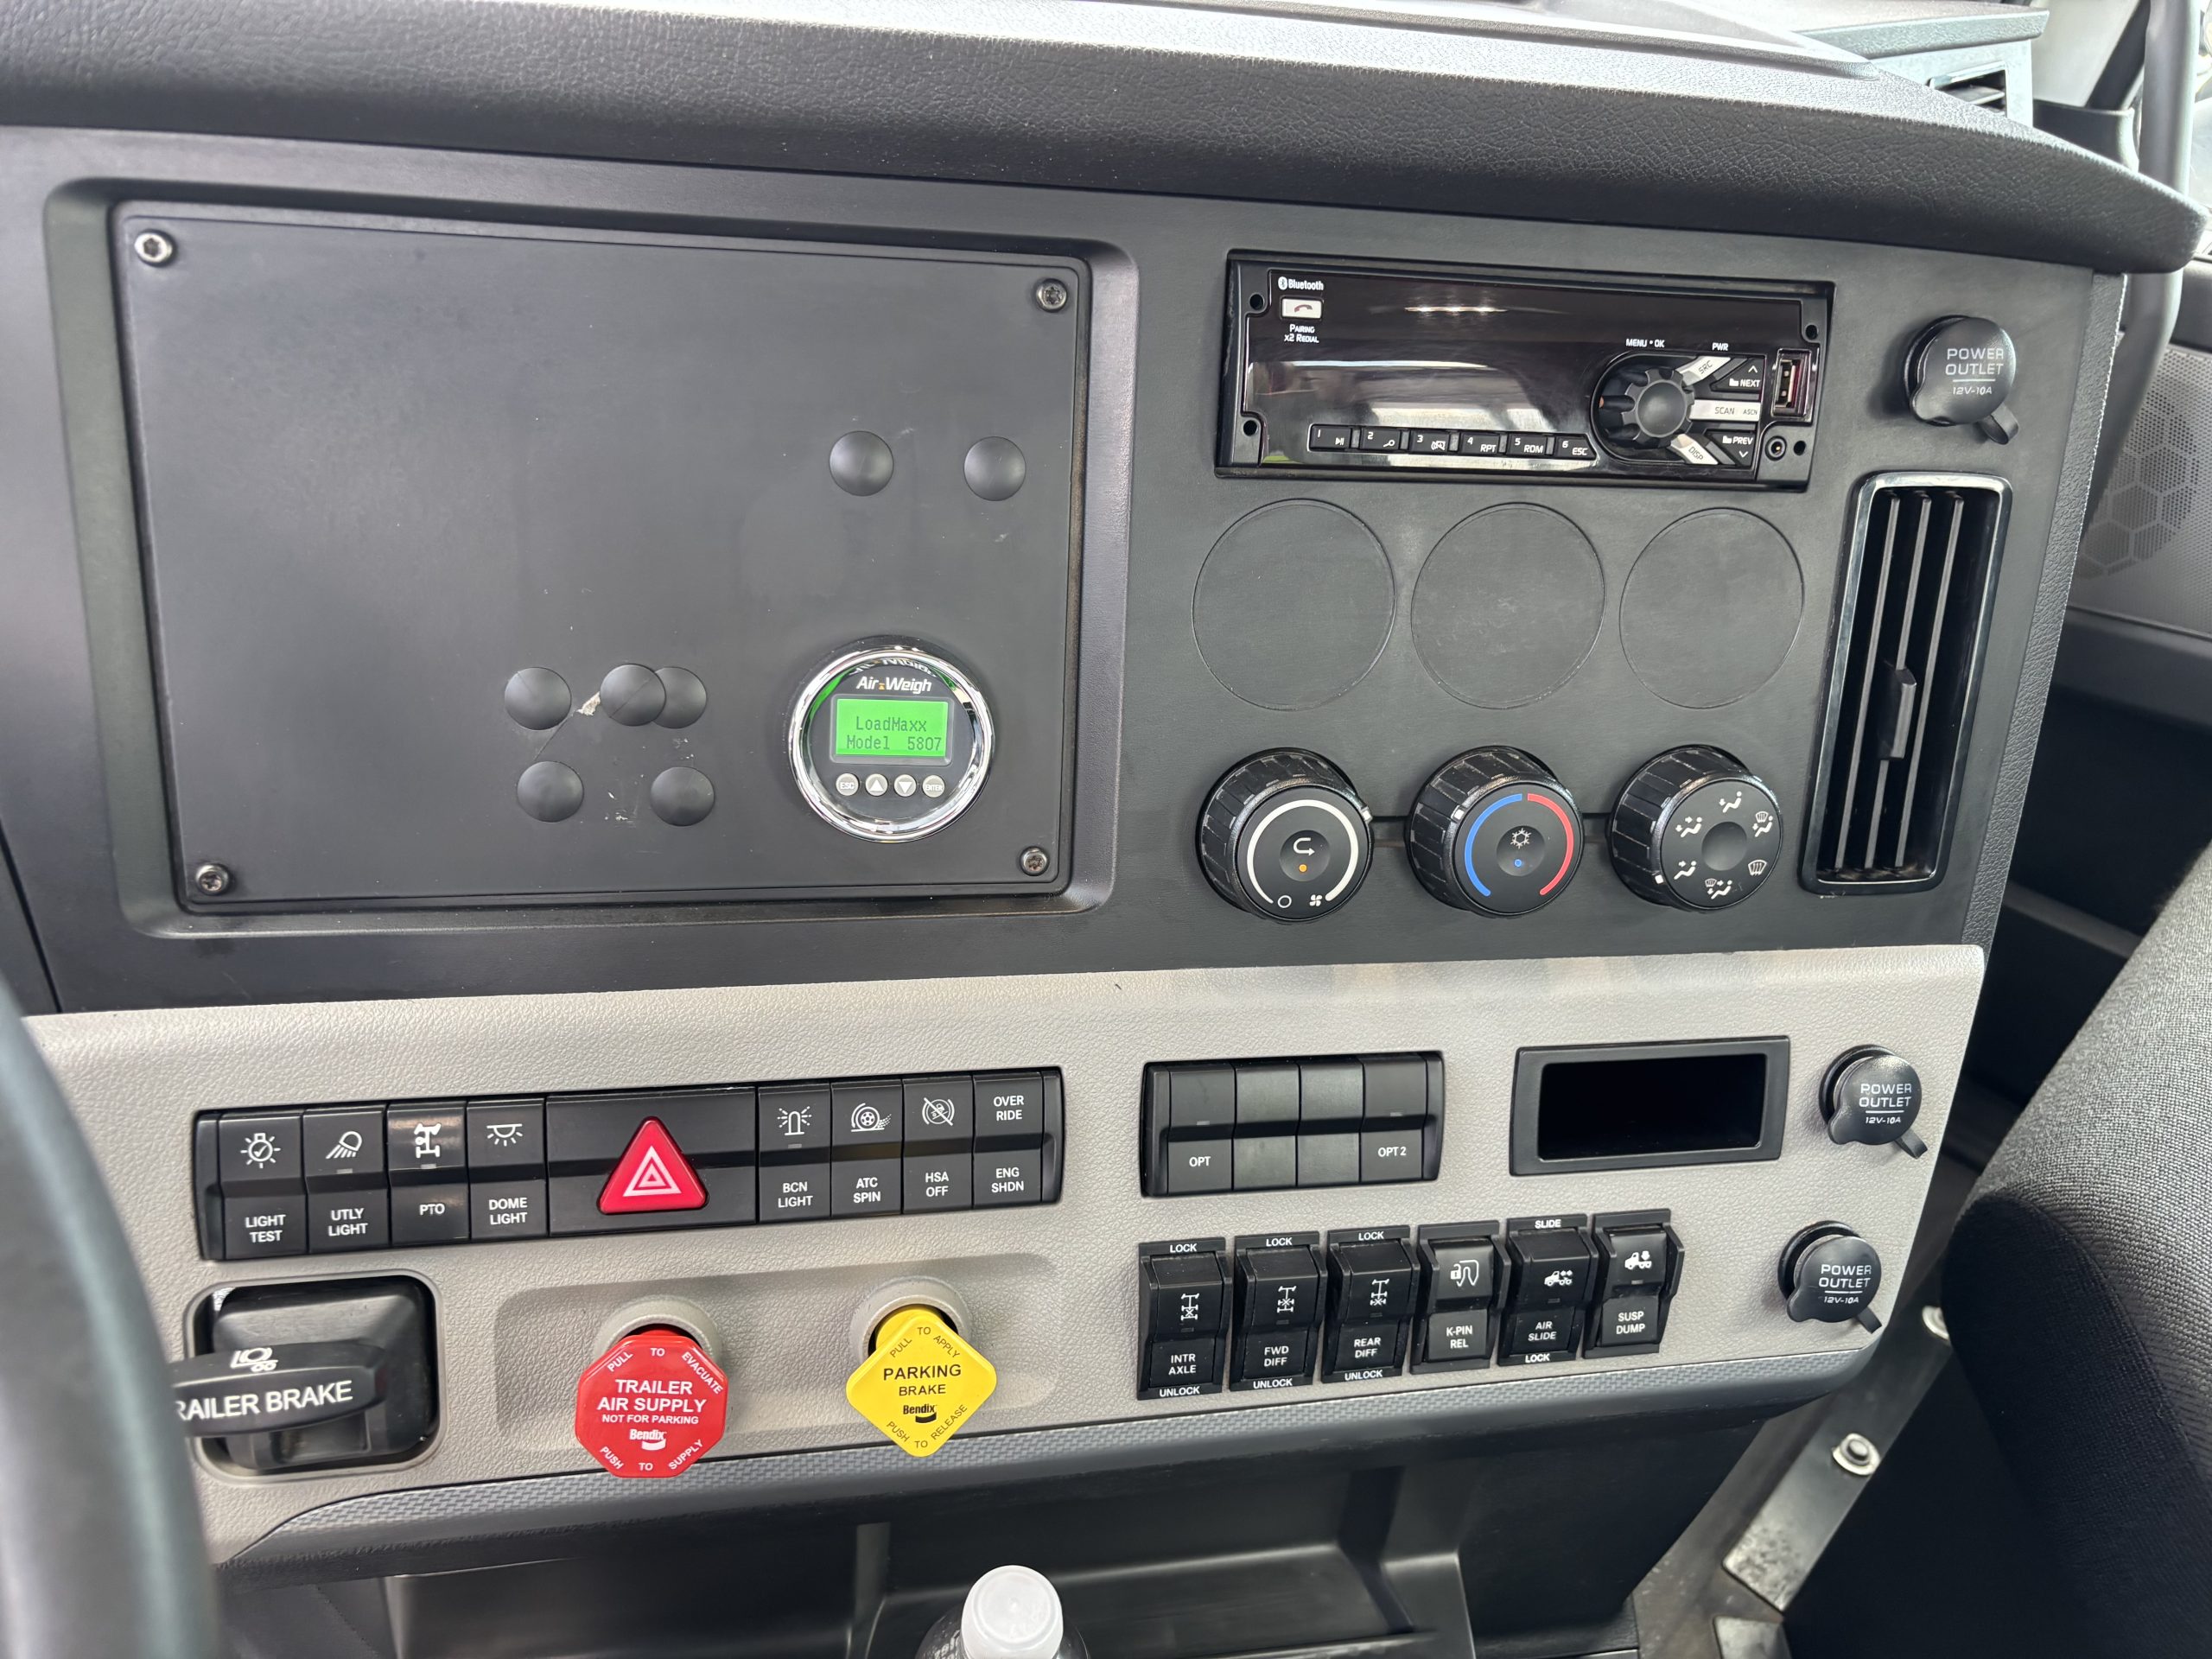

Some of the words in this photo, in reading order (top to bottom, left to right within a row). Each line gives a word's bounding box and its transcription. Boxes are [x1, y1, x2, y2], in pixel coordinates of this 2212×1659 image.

[1288, 279, 1324, 291] Bluetooth
[1626, 339, 1647, 347] MENU
[1654, 340, 1665, 348] OK
[1712, 343, 1729, 351] PWR
[1947, 348, 2004, 360] POWER
[1698, 360, 1713, 374] SRC
[1945, 363, 2004, 375] OUTLET
[1740, 378, 1760, 388] NEXT
[1953, 386, 1992, 395] 12V-10A
[1714, 406, 1735, 415] SCAN
[1367, 432, 1374, 440] 2
[1417, 435, 1424, 443] 3
[1467, 437, 1474, 445] 4
[1732, 436, 1754, 445] PREV
[1515, 438, 1521, 446] 5
[1480, 444, 1497, 453] RPT
[1572, 447, 1588, 456] ESC
[1688, 446, 1704, 460] DISP
[856, 716, 927, 732] LoadMaxx
[847, 735, 890, 750] Model
[907, 737, 941, 751] 5807
[840, 782, 855, 790] ESC
[1860, 1083, 1912, 1094] POWER
[993, 1095, 1024, 1107] OVER
[1859, 1096, 1911, 1107] OUTLET
[996, 1110, 1023, 1121] RIDE
[1378, 1147, 1399, 1157] OPT
[1400, 1146, 1407, 1157] 2
[1189, 1156, 1211, 1167] OPT
[925, 1172, 949, 1183] HSA
[996, 1167, 1020, 1179] ENG
[783, 1181, 808, 1193] BCN
[856, 1177, 878, 1189] ATC
[992, 1180, 1024, 1193] SHDN
[926, 1186, 949, 1197] OFF
[489, 1197, 528, 1210] DOME
[778, 1195, 813, 1208] LIGHT
[853, 1192, 881, 1204] SPIN
[331, 1208, 364, 1220] UTLY
[420, 1203, 445, 1215] PTO
[245, 1214, 286, 1228] LIGHT
[490, 1212, 528, 1225] LIGHT
[328, 1223, 368, 1236] LIGHT
[1535, 1219, 1561, 1230] SLIDE
[249, 1230, 283, 1243] TEST
[1358, 1230, 1384, 1241] LOCK
[1266, 1237, 1292, 1247] LOCK
[1170, 1243, 1197, 1253] LOCK
[1821, 1264, 1872, 1275] POWER
[1819, 1278, 1871, 1288] OUTLET
[1618, 1311, 1644, 1322] SUSP
[1446, 1325, 1473, 1337] K-PIN
[1535, 1321, 1552, 1330] AIR
[1616, 1323, 1646, 1335] DUMP
[1528, 1331, 1557, 1341] SLIDE
[890, 1338, 912, 1358] PULL
[918, 1327, 931, 1335] TO
[933, 1335, 960, 1358] APPLY
[1354, 1337, 1381, 1348] REAR
[1450, 1338, 1468, 1349] REL
[1264, 1346, 1289, 1356] FWD
[1355, 1348, 1378, 1359] DIFF
[1171, 1353, 1196, 1363] INTR
[1264, 1357, 1287, 1367] DIFF
[1525, 1353, 1550, 1363] LOCK
[607, 1351, 633, 1372] PULL
[650, 1348, 665, 1357] TO
[681, 1351, 724, 1394] EVACUATE
[883, 1363, 962, 1380] PARKING
[1169, 1364, 1197, 1376] AXLE
[1344, 1369, 1383, 1381] UNLOCK
[615, 1379, 693, 1395] TRAILER
[1253, 1378, 1293, 1389] UNLOCK
[899, 1384, 946, 1396] BRAKE
[1159, 1386, 1200, 1398] UNLOCK
[265, 1380, 353, 1412] BRAKE
[597, 1397, 629, 1411] AIR
[633, 1398, 707, 1413] SUPPLY
[903, 1404, 935, 1414] Bendix
[602, 1414, 624, 1423] NOT
[627, 1414, 649, 1424] FOR
[652, 1415, 699, 1424] PARKING
[886, 1421, 910, 1442] PUSH
[915, 1440, 928, 1449] TO
[931, 1404, 967, 1440] RELEASE
[629, 1428, 665, 1440] Bendix
[600, 1446, 624, 1469] PUSH
[639, 1462, 653, 1471] TO
[668, 1439, 704, 1470] SUPPLY
